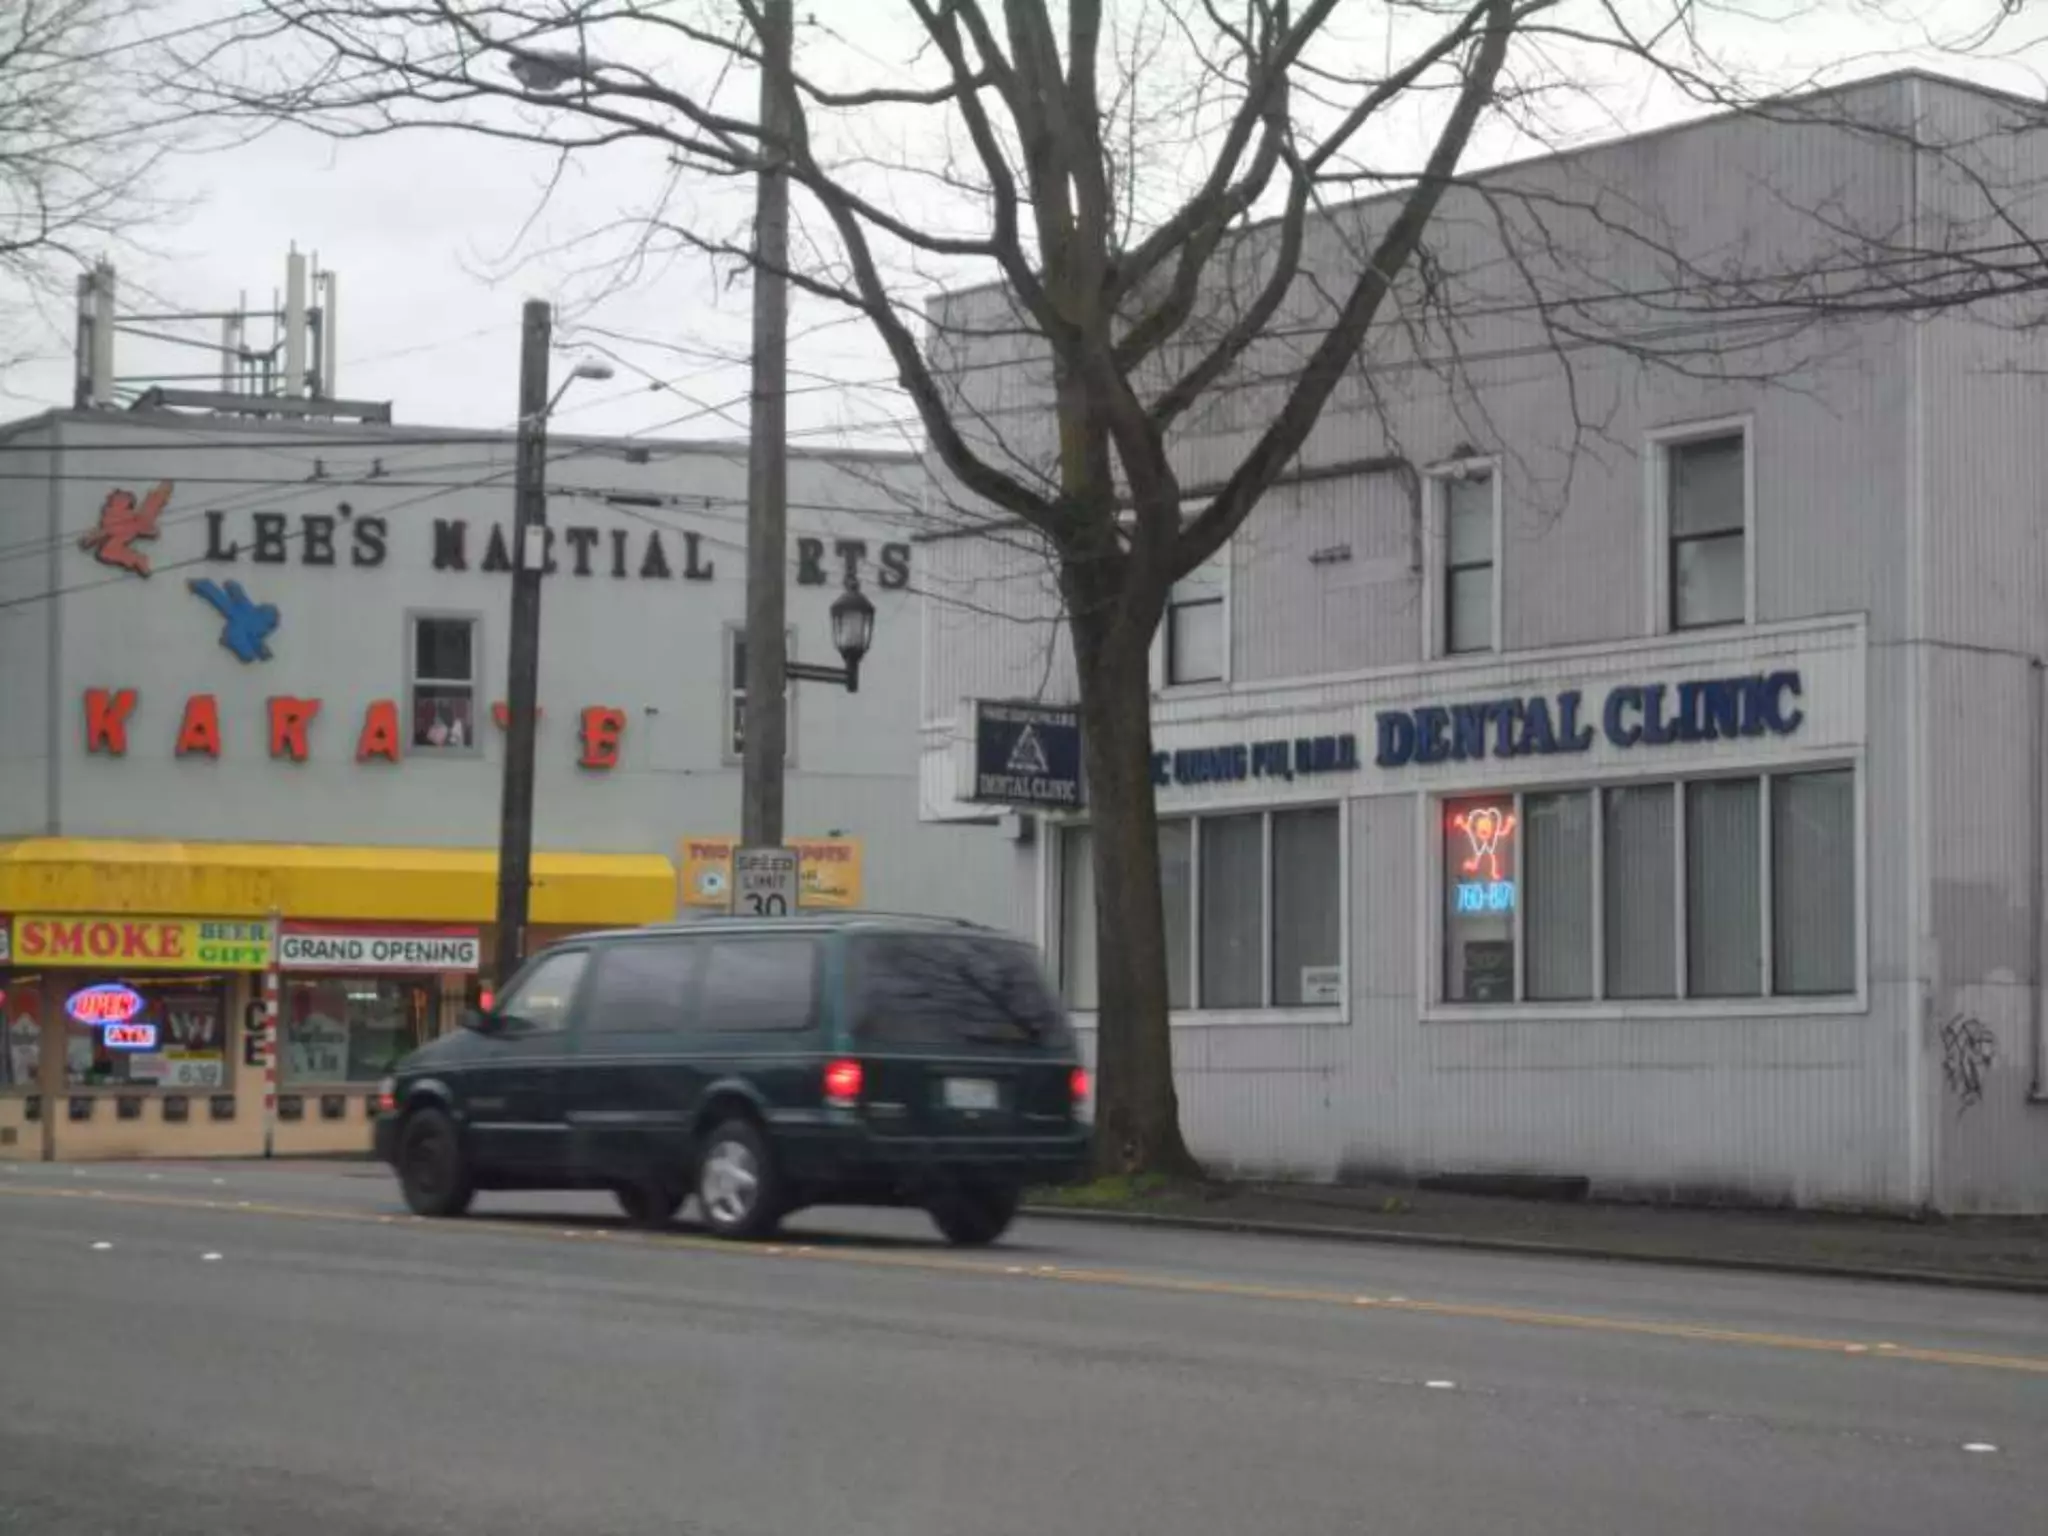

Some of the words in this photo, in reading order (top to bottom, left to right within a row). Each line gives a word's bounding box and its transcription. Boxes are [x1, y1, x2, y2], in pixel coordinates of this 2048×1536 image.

[205, 502, 388, 567] LEE'S
[796, 536, 911, 591] RTS
[84, 688, 625, 769] KARAE
[1375, 691, 1595, 768] DENTAL
[1603, 671, 1804, 748] CLINIC
[738, 855, 793, 871] SPEED
[744, 873, 786, 890] LIMIT
[745, 893, 787, 917] 30
[21, 921, 184, 959] SMOKE
[200, 923, 266, 942] BEER
[199, 946, 266, 963] GIFT
[284, 938, 364, 960] GRAND
[372, 940, 475, 964] OPENING
[72, 990, 137, 1020] OPEN
